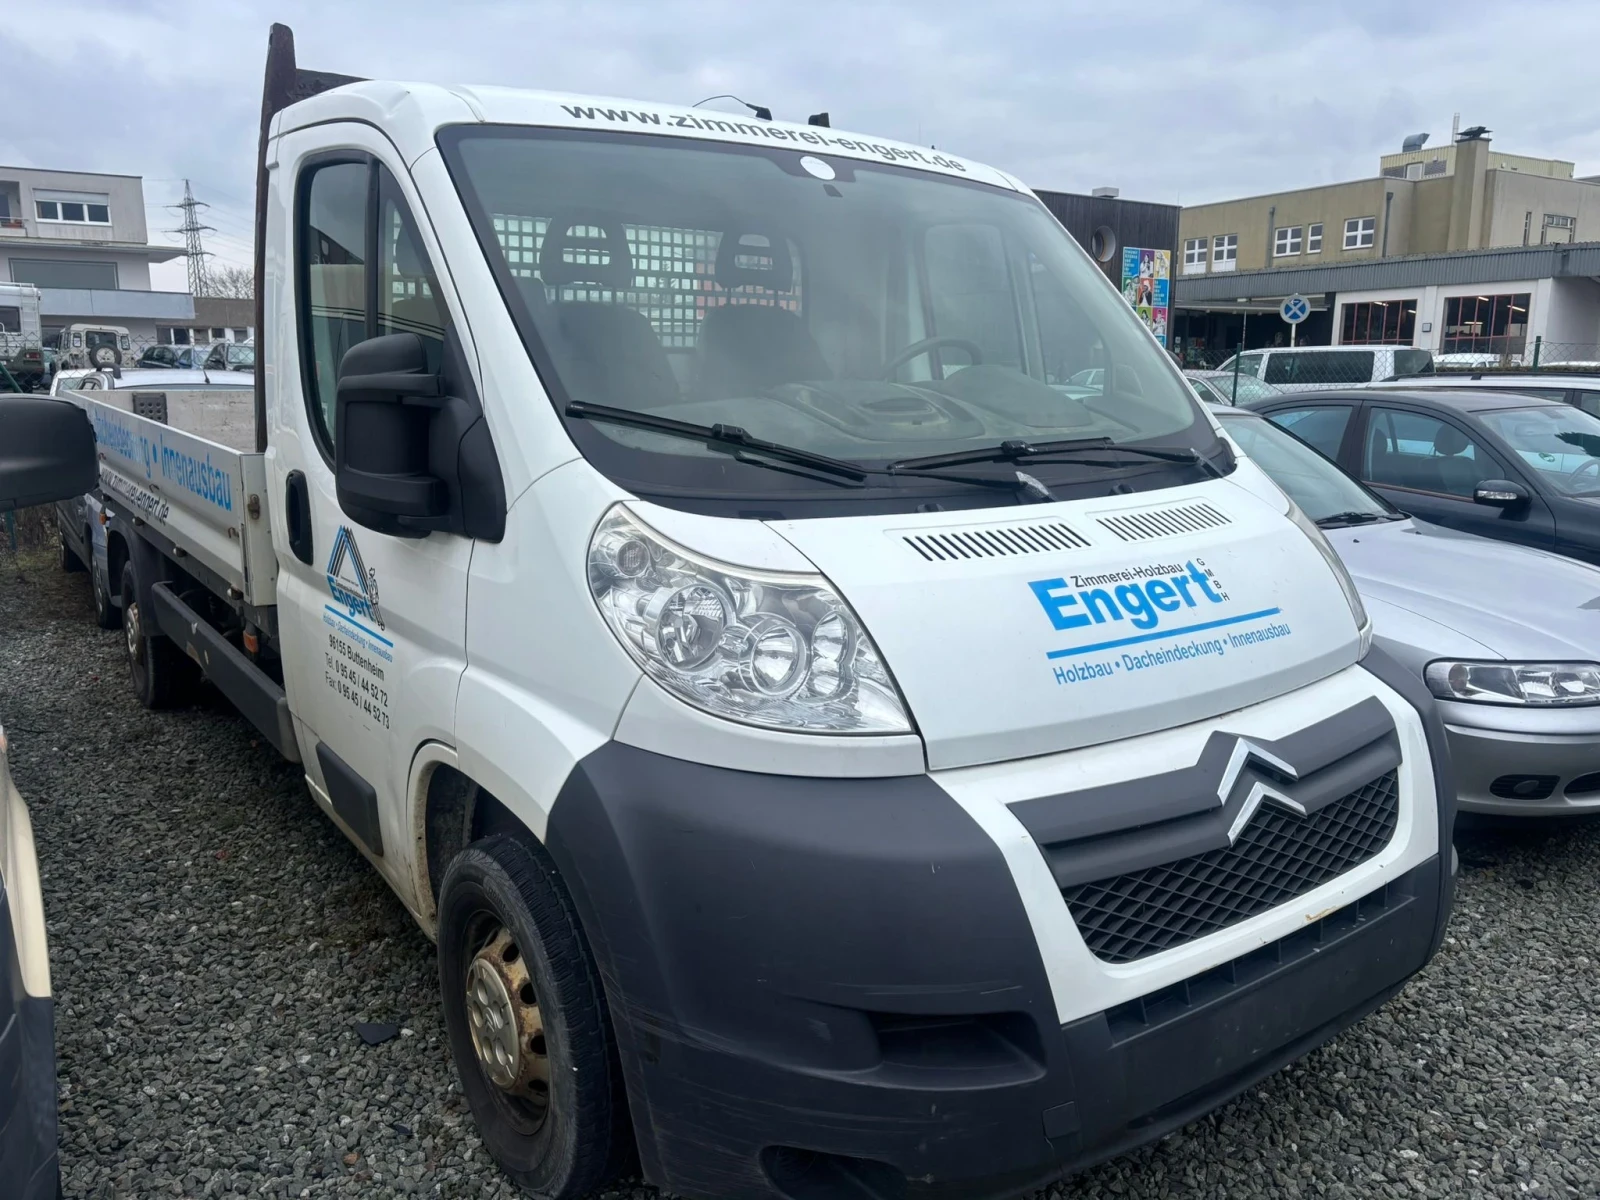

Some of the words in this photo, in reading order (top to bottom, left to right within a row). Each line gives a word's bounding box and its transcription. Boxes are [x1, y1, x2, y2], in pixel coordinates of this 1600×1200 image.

[560, 104, 966, 172] www.zimmerei-engert.de
[160, 433, 232, 512] Innenausbau
[327, 575, 376, 623] Engert
[1027, 560, 1223, 631] Engert
[1070, 562, 1184, 588] Zimmerei-Holzbau
[329, 634, 346, 656] 96155
[347, 645, 385, 681] Buttenheim
[1053, 659, 1114, 685] Holzbau
[1121, 637, 1224, 671] Dacheindeckung
[1227, 621, 1291, 649] Innenausbau
[335, 660, 340, 673] 0
[340, 663, 348, 679] 95
[349, 669, 356, 685] 45
[361, 677, 369, 694] 44
[370, 683, 379, 701] 52
[380, 689, 388, 708] 72
[337, 680, 342, 694] 0
[342, 683, 350, 700] 95
[351, 690, 359, 706] 45
[363, 699, 372, 715] 44
[373, 705, 381, 723] 52
[382, 712, 390, 730] 73
